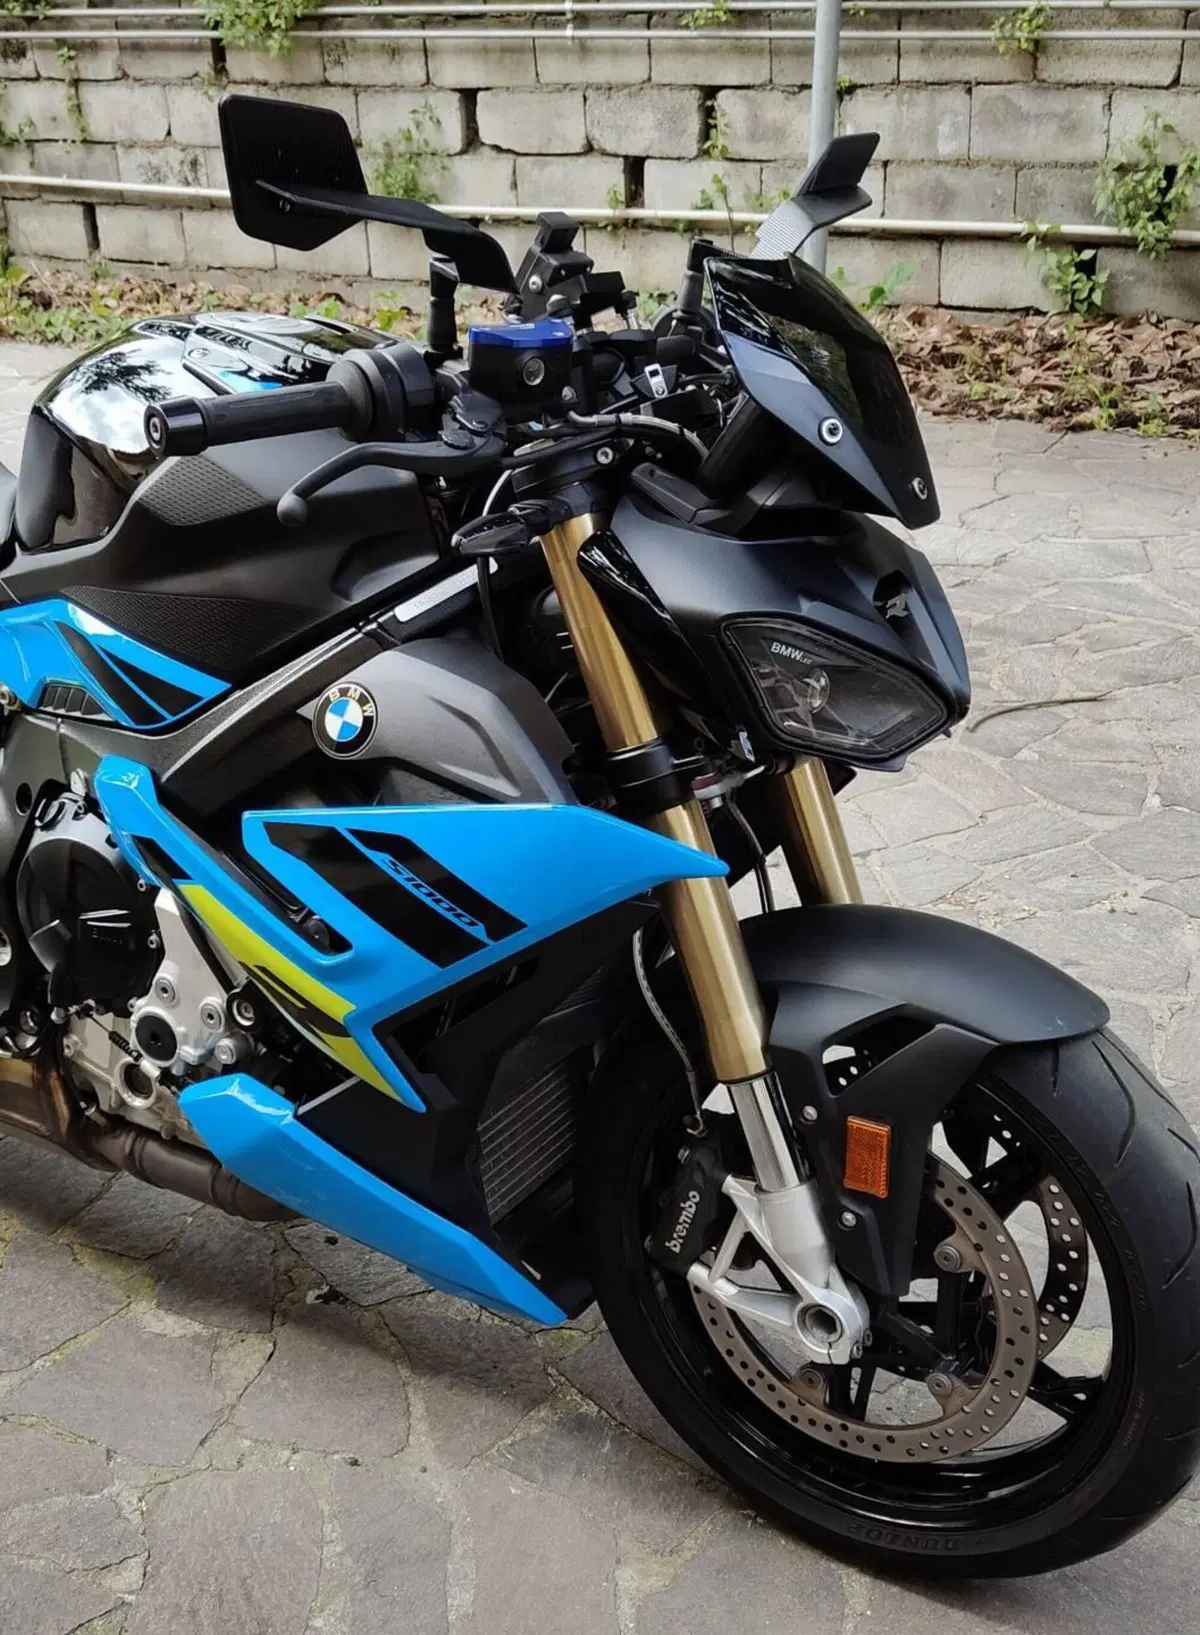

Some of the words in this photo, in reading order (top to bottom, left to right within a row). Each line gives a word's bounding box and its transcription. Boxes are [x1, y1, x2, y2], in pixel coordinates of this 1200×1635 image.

[770, 641, 803, 661] BMW
[328, 686, 375, 717] BMW
[378, 857, 480, 928] S1000
[665, 1190, 700, 1254] brembo
[847, 1522, 963, 1551] DUNLOP
